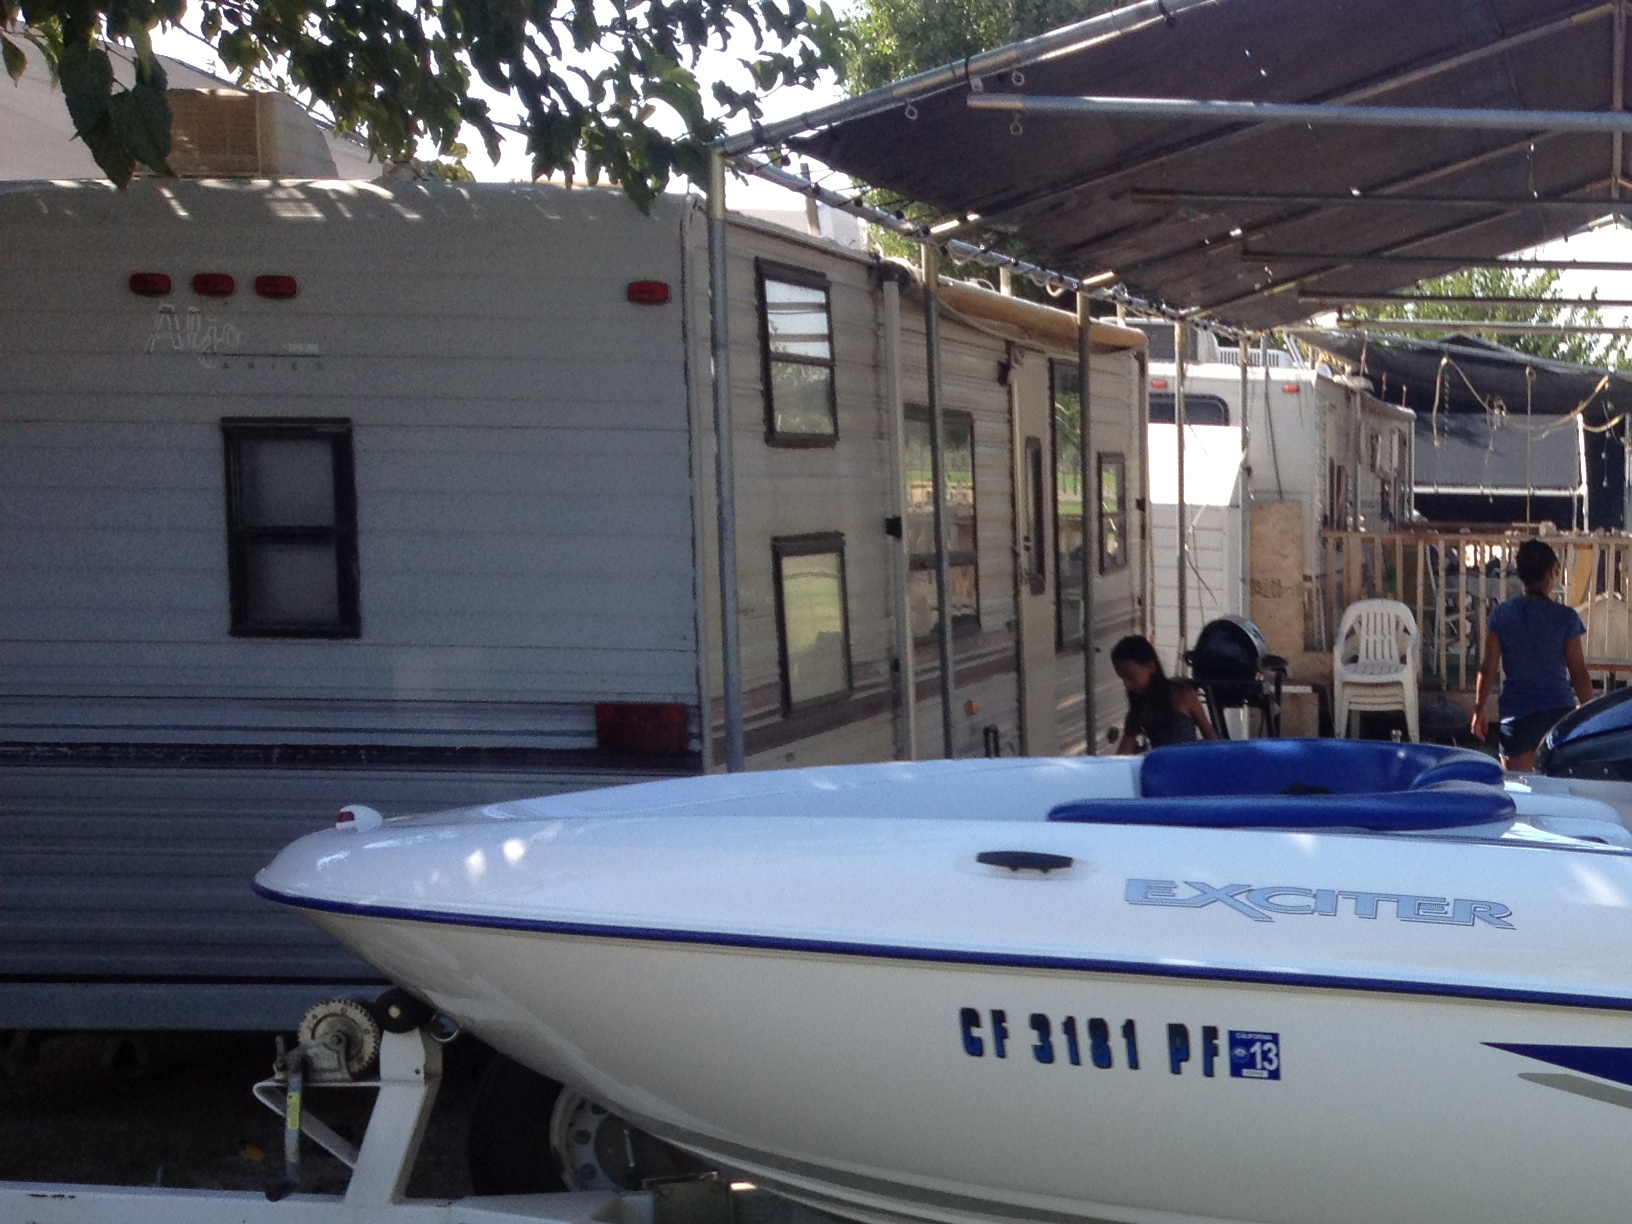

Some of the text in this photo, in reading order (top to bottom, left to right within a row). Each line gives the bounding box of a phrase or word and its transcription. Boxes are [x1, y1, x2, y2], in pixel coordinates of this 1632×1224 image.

[1125, 878, 1516, 930] EXCITER
[959, 1007, 1219, 1078] CF 3181 PF
[1235, 1032, 1273, 1040] CALIFORNIA
[1250, 1041, 1279, 1071] 13
